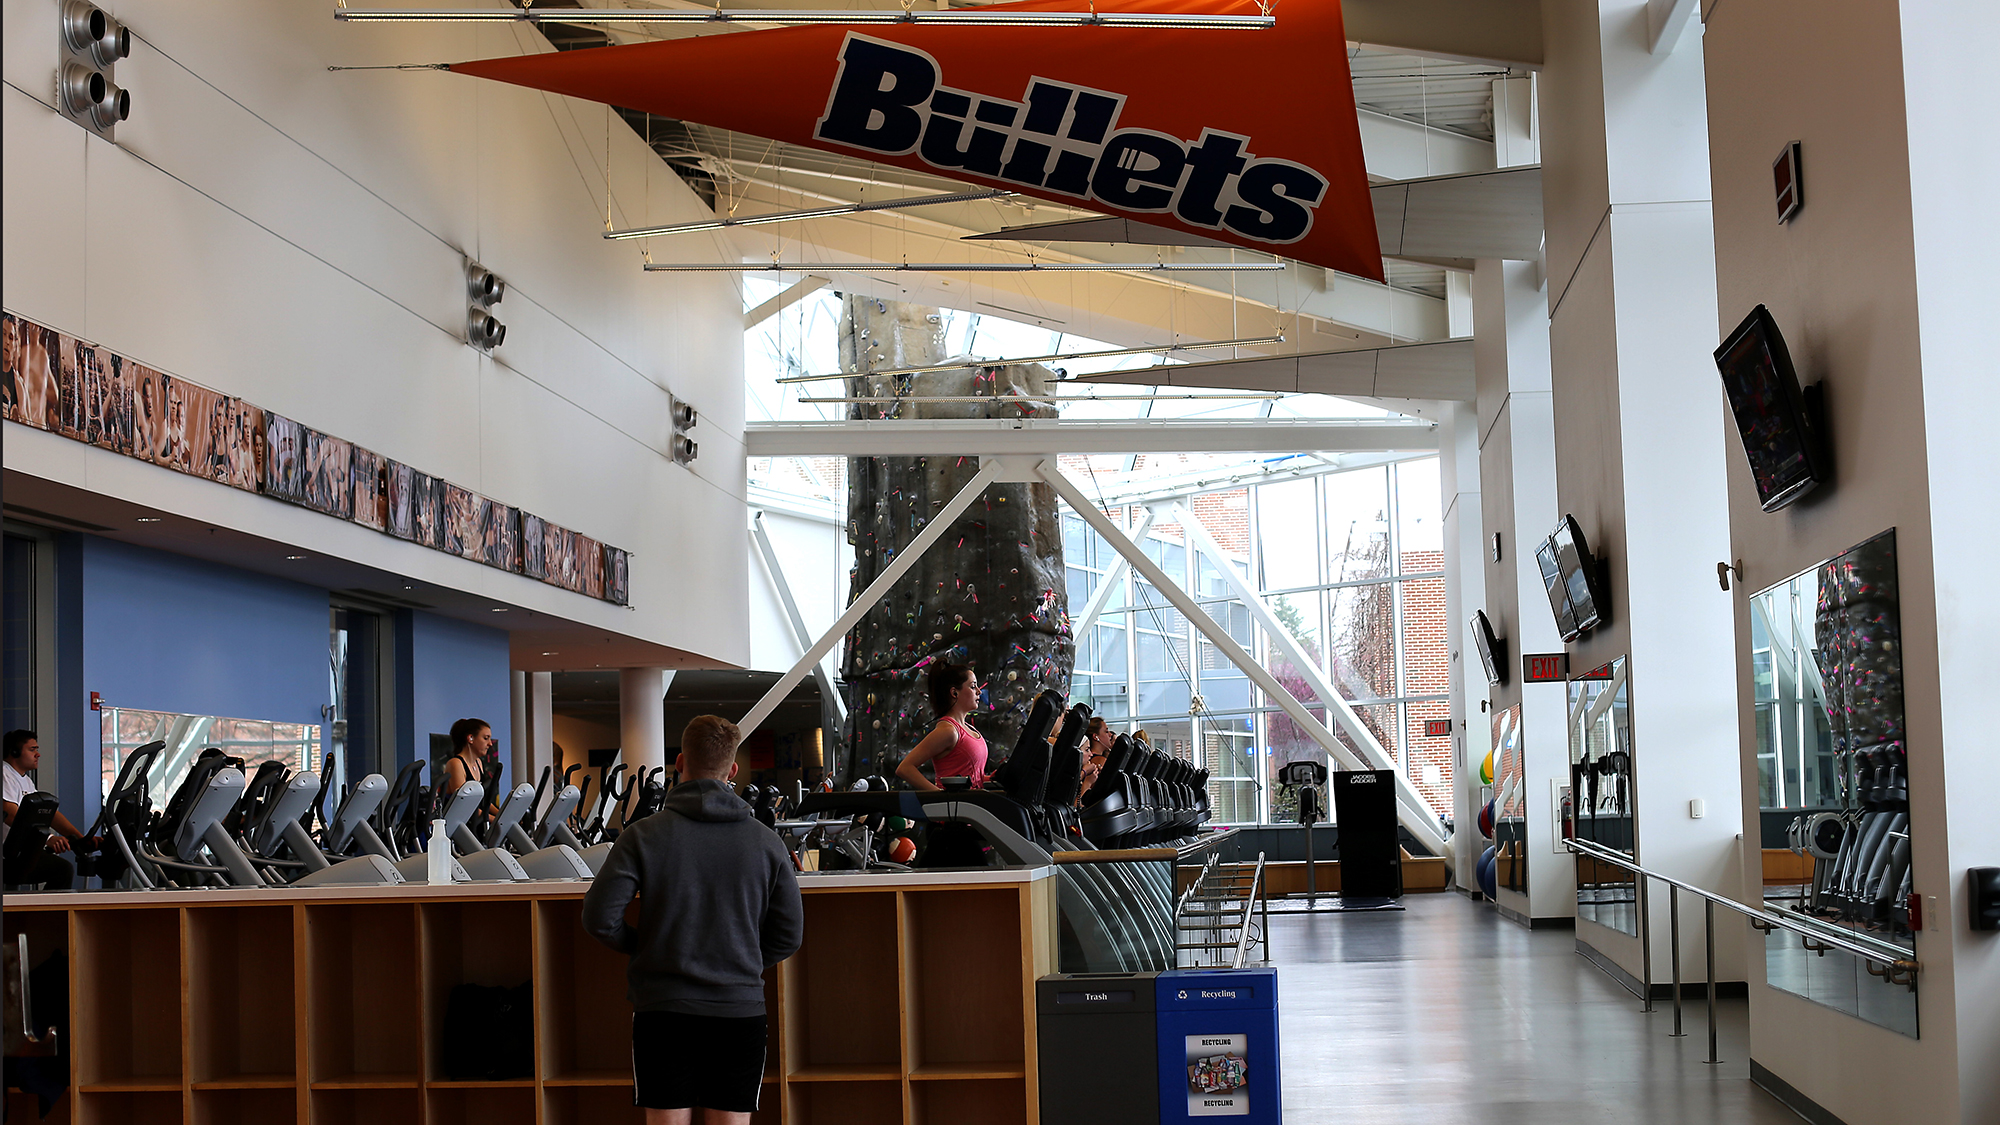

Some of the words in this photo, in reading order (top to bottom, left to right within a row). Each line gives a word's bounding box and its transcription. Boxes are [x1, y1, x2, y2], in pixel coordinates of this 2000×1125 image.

[813, 31, 1329, 243] Bullets
[1532, 657, 1559, 679] EXIT
[1430, 722, 1446, 735] EXIT
[1085, 993, 1108, 1001] Trash
[1201, 990, 1236, 999] Recycling
[1201, 1038, 1231, 1046] RECYCLING
[1203, 1099, 1234, 1107] RECYCLING
